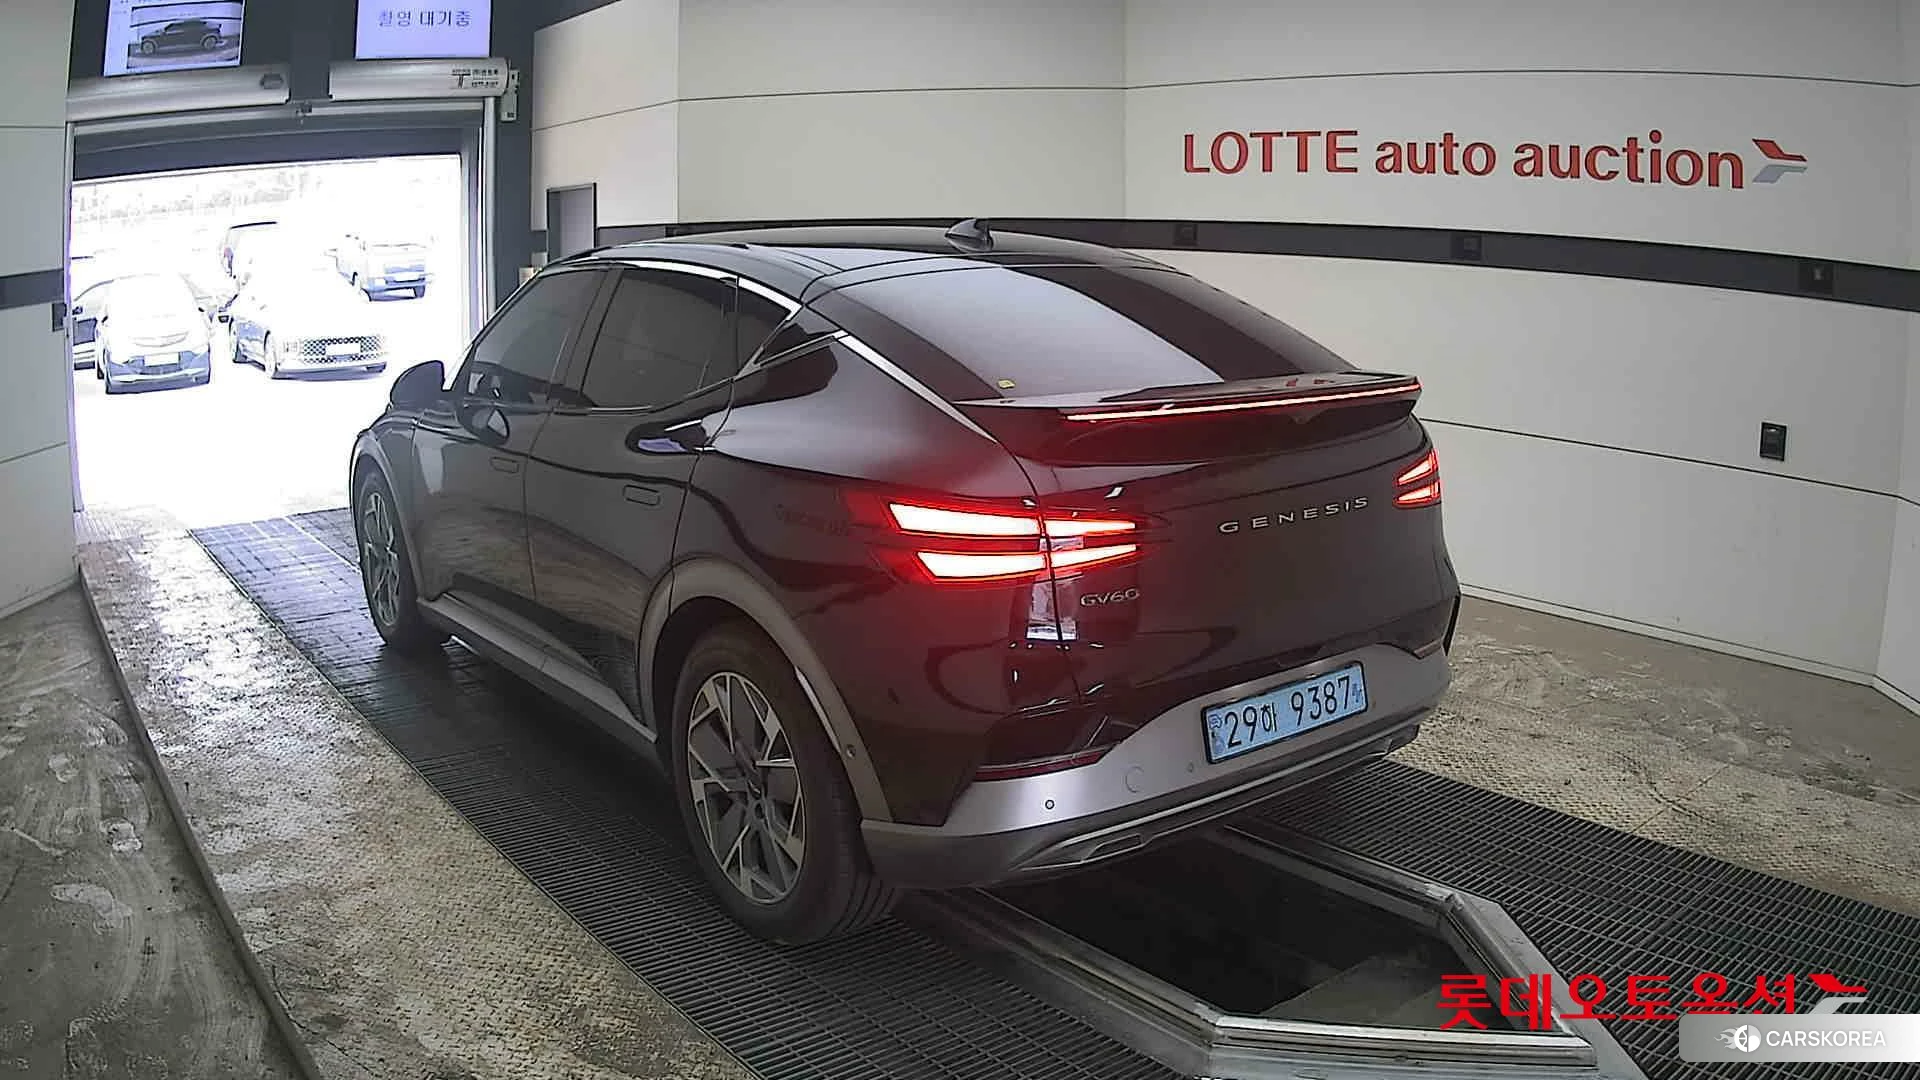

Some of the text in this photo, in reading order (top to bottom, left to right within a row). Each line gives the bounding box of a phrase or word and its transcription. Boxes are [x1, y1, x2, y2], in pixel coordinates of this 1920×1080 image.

[419, 9, 472, 28] 대기중
[1184, 130, 1744, 190] LOTTE auto auction
[1218, 496, 1370, 534] GENESIS
[1080, 587, 1141, 608] GV60
[1224, 702, 1278, 750] 29하
[1290, 675, 1350, 727] 9387
